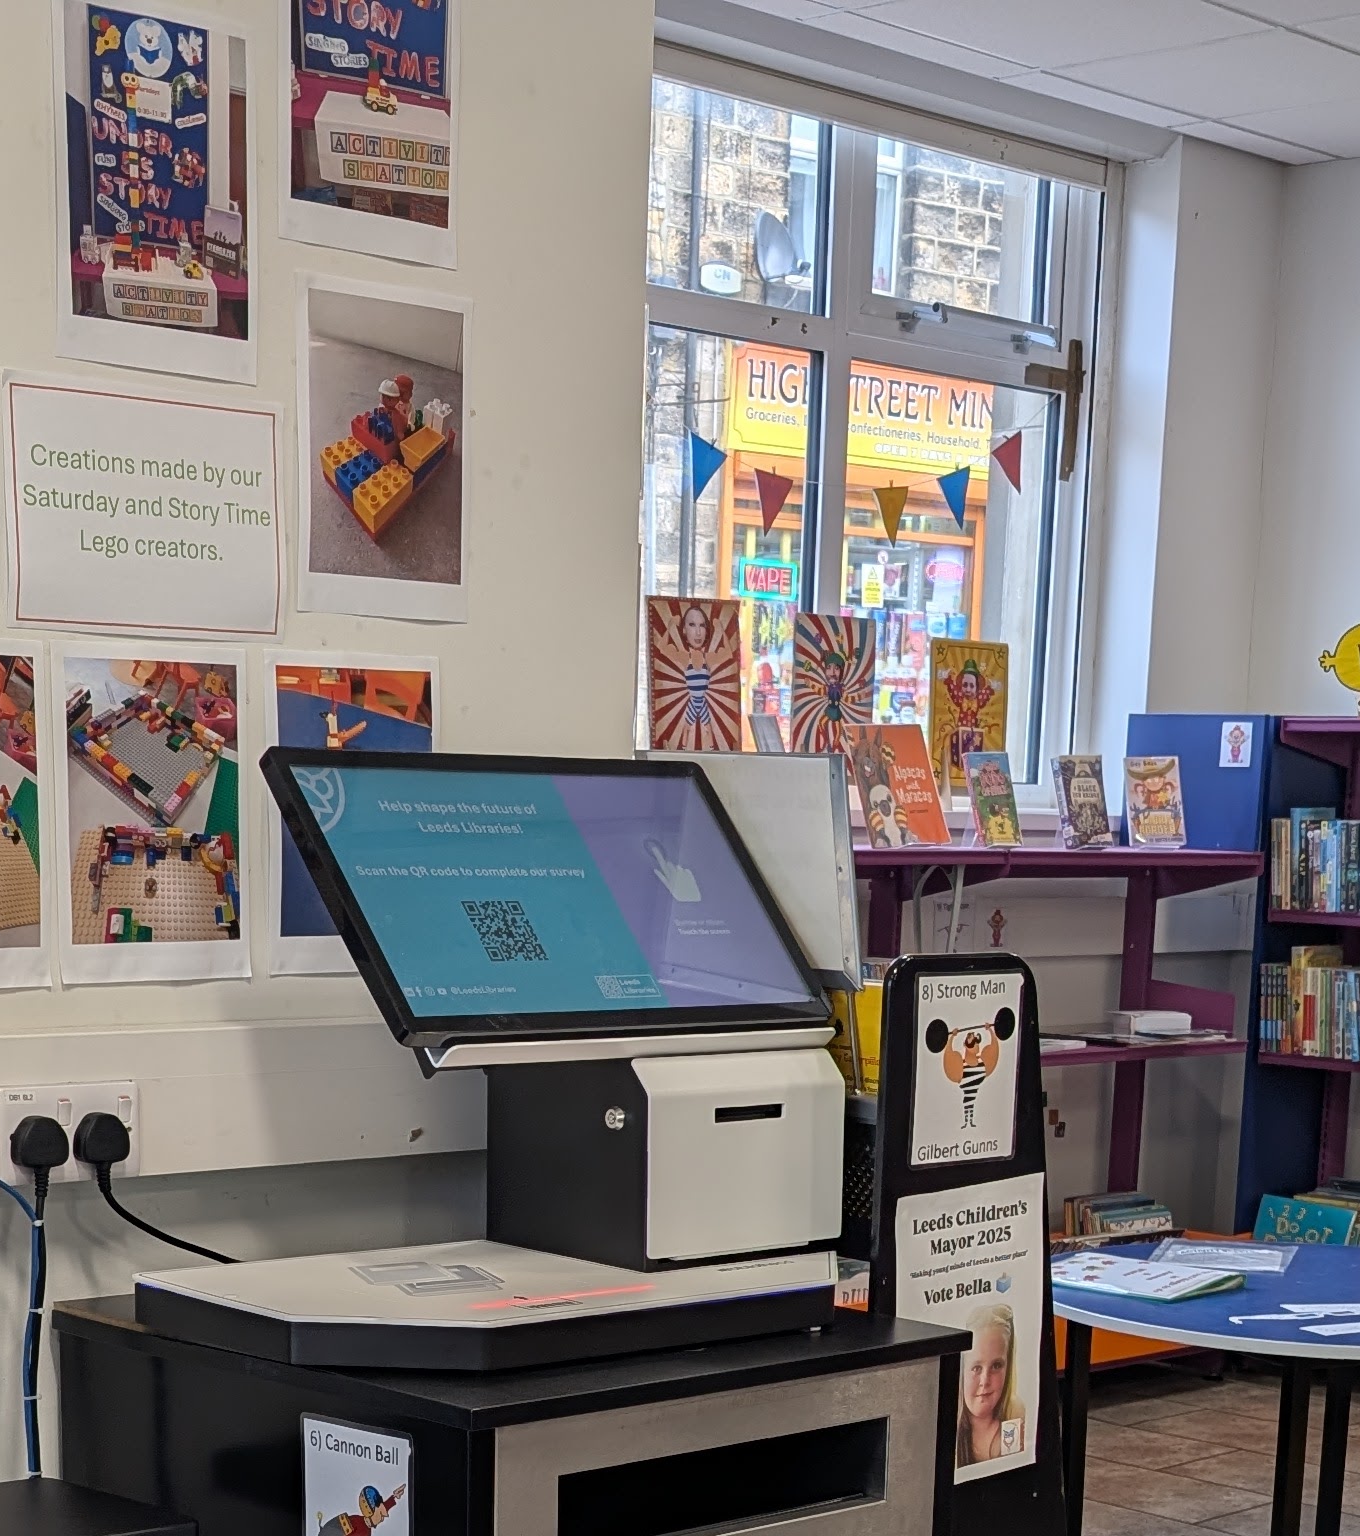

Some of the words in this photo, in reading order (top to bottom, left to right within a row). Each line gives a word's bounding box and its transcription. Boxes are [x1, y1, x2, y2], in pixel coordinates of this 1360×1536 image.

[333, 54, 368, 66] STORIES
[366, 39, 440, 87] TIME
[347, 162, 448, 186] STATION
[144, 211, 203, 245] TIME
[115, 286, 207, 306] ACTIVITY
[123, 304, 201, 321] STATION
[848, 374, 941, 423] TREET
[745, 406, 800, 427] Groceries,
[848, 421, 924, 443] onfectioneries,
[29, 444, 136, 476] Creations
[141, 458, 198, 481] made
[203, 461, 226, 487] by
[231, 468, 262, 488] our
[23, 484, 120, 516] Saturday
[125, 494, 163, 515] and
[169, 499, 219, 525] Story
[223, 502, 271, 527] Time
[80, 529, 129, 558] Lego
[134, 537, 223, 562] creators.
[743, 564, 792, 596] VAPE
[893, 765, 926, 783] Alpacas
[378, 800, 413, 814] Help
[415, 801, 456, 815] shape
[457, 802, 480, 814] the
[481, 803, 522, 814] future
[524, 804, 537, 815] of
[896, 790, 933, 806] Maracas
[418, 821, 460, 833] Leeds
[461, 822, 524, 834] Libraries!
[356, 865, 387, 876] Scan
[389, 866, 408, 876] the
[409, 866, 429, 878] QR
[430, 867, 459, 877] code
[460, 867, 473, 877] to
[475, 866, 528, 879] complete
[530, 869, 548, 877] our
[549, 869, 585, 879] survey
[450, 986, 517, 996] @LeedsLibraries
[921, 983, 934, 1003] 8)
[937, 982, 976, 1003] Strong
[980, 979, 1006, 997] Man
[917, 1142, 958, 1162] Gilbert
[961, 1138, 998, 1155] Gunns
[913, 1213, 953, 1235] Leeds
[956, 1200, 1028, 1226] Children's
[931, 1235, 974, 1256] Mayor
[977, 1225, 1011, 1246] 2025
[924, 1288, 953, 1305] Vote
[956, 1278, 991, 1299] Bella
[310, 1430, 321, 1451] 6)
[325, 1433, 371, 1460] Cannon
[376, 1444, 399, 1465] Ball
